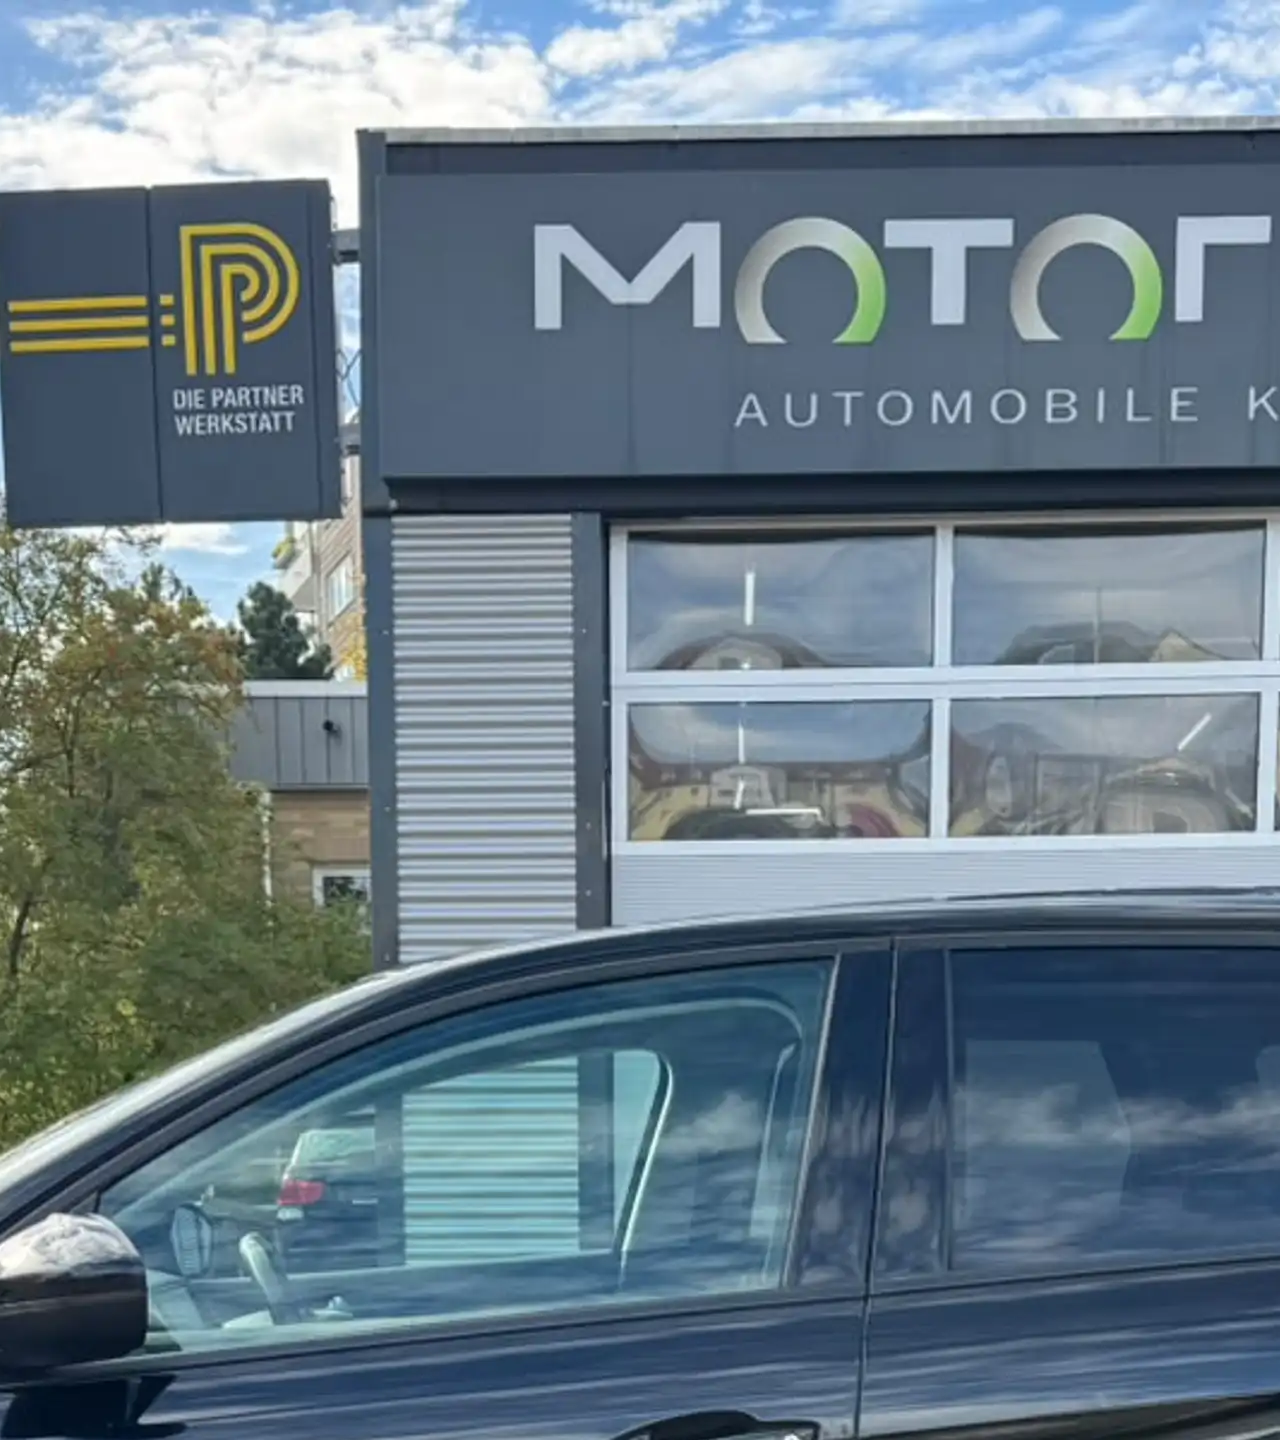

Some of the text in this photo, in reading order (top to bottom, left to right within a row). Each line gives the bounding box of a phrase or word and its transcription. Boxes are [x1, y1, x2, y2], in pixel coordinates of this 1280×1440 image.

[173, 384, 305, 410] DIE PARTNER
[734, 386, 1200, 428] AUTOMOBILE
[174, 411, 296, 436] WERKSTATT
